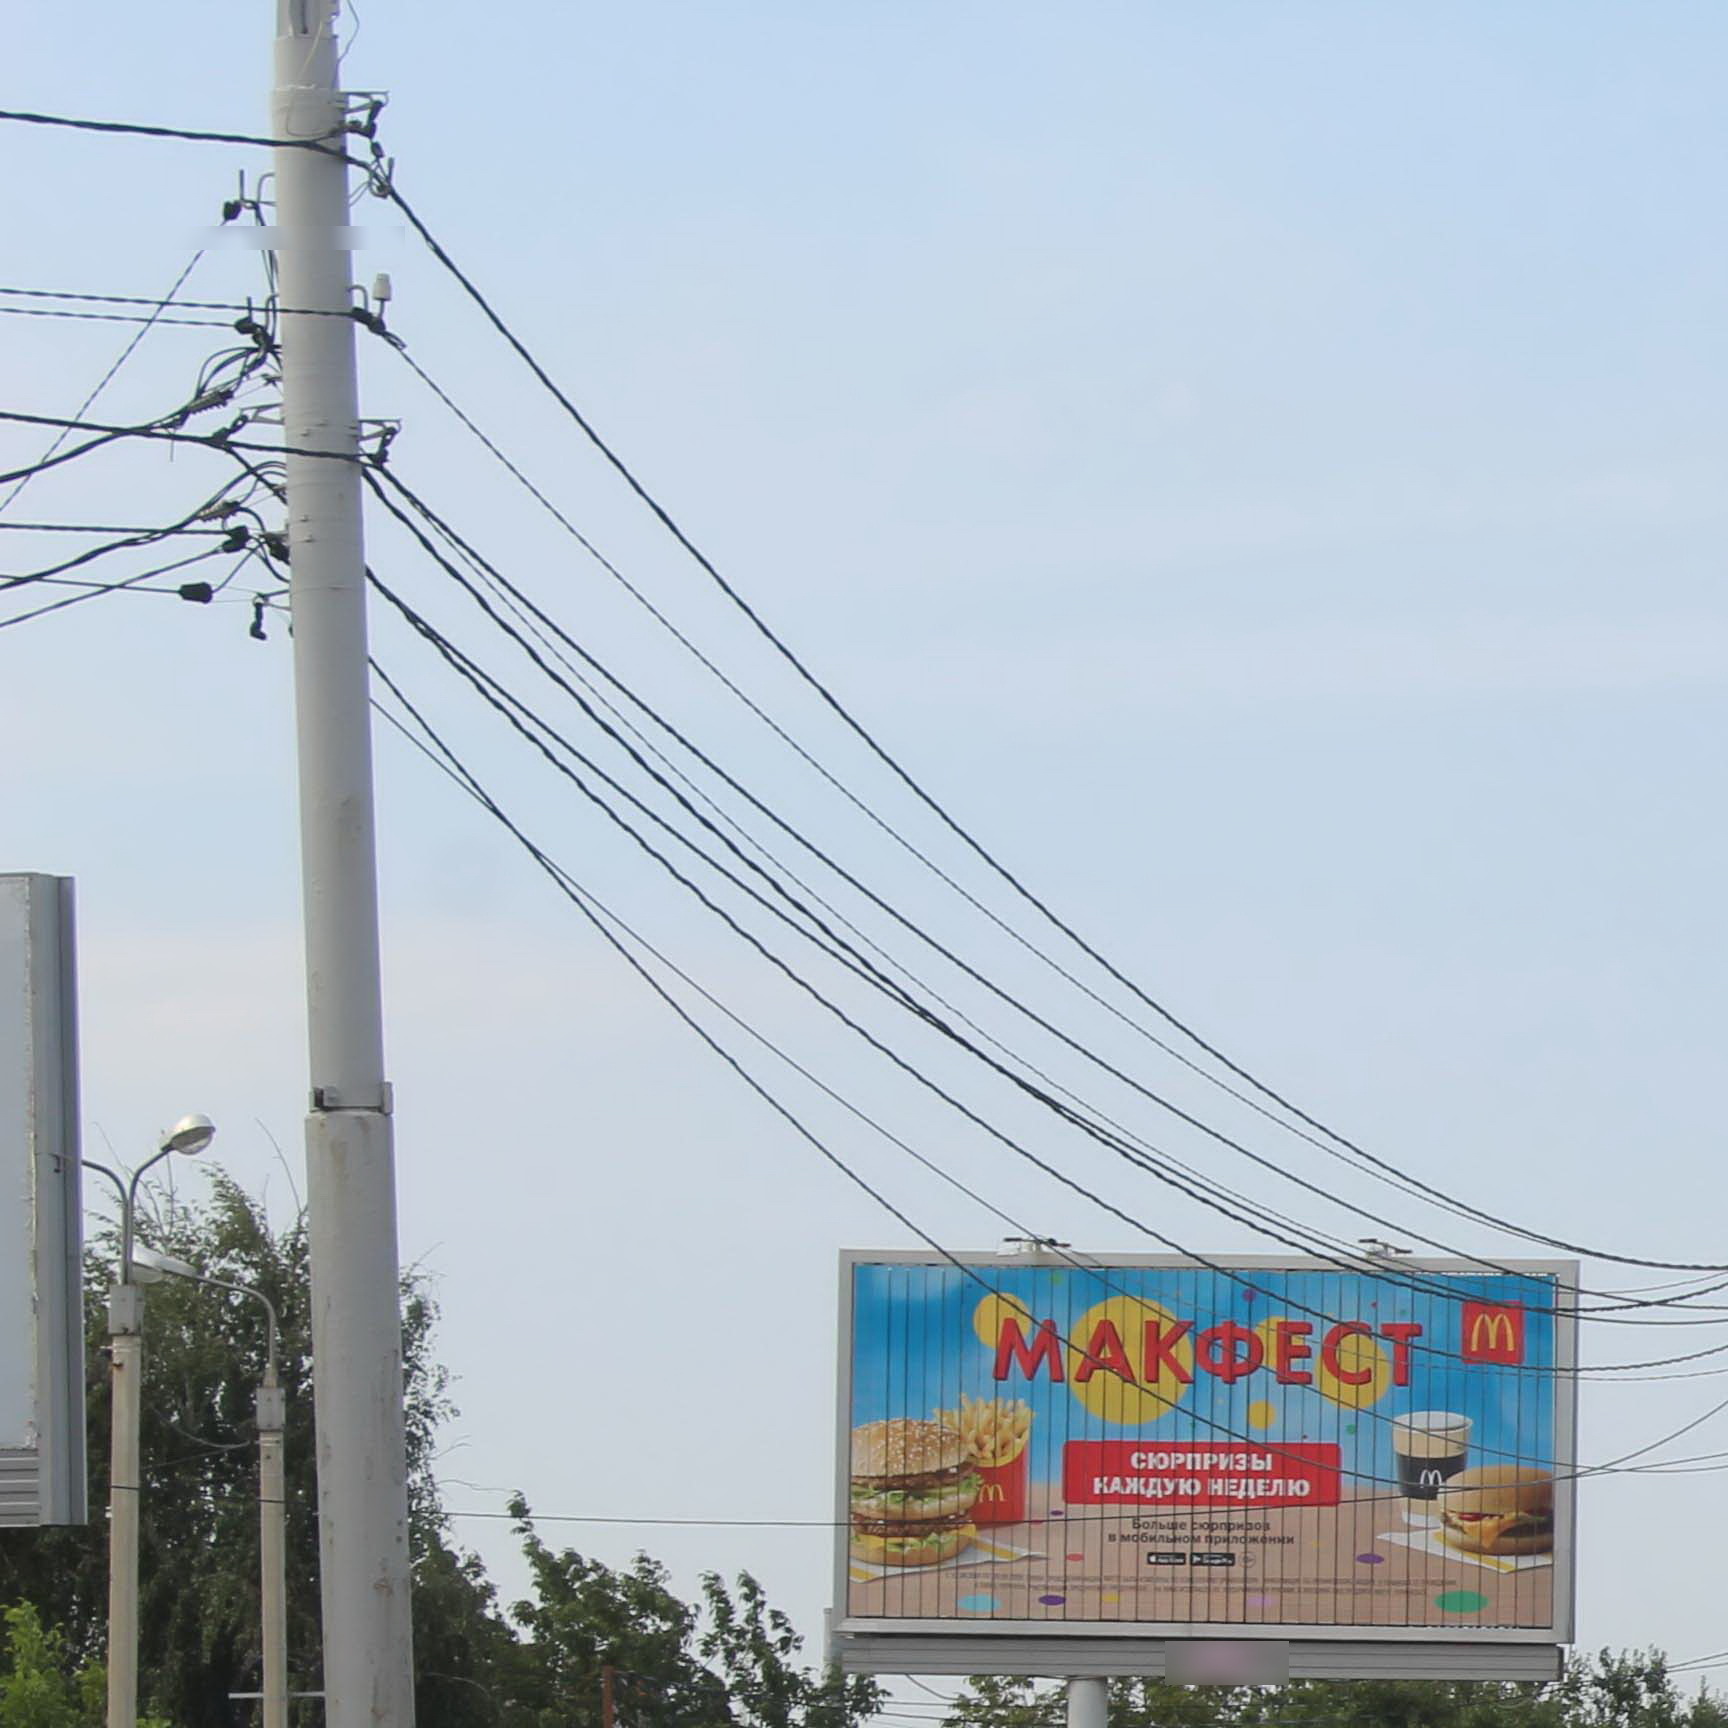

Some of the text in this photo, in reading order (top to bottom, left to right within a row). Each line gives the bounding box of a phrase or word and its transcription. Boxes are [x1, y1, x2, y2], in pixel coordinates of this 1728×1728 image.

[991, 1317, 1424, 1387] МАКФЕСТ
[1130, 1451, 1273, 1472] СЮРПРИЗЫ
[1093, 1476, 1311, 1499] КАЖДУЮ НЕДЕЛЮ
[1131, 1518, 1271, 1533] Больше сюрпризов
[1119, 1531, 1201, 1545] мобильном
[1203, 1533, 1295, 1546] приложении
